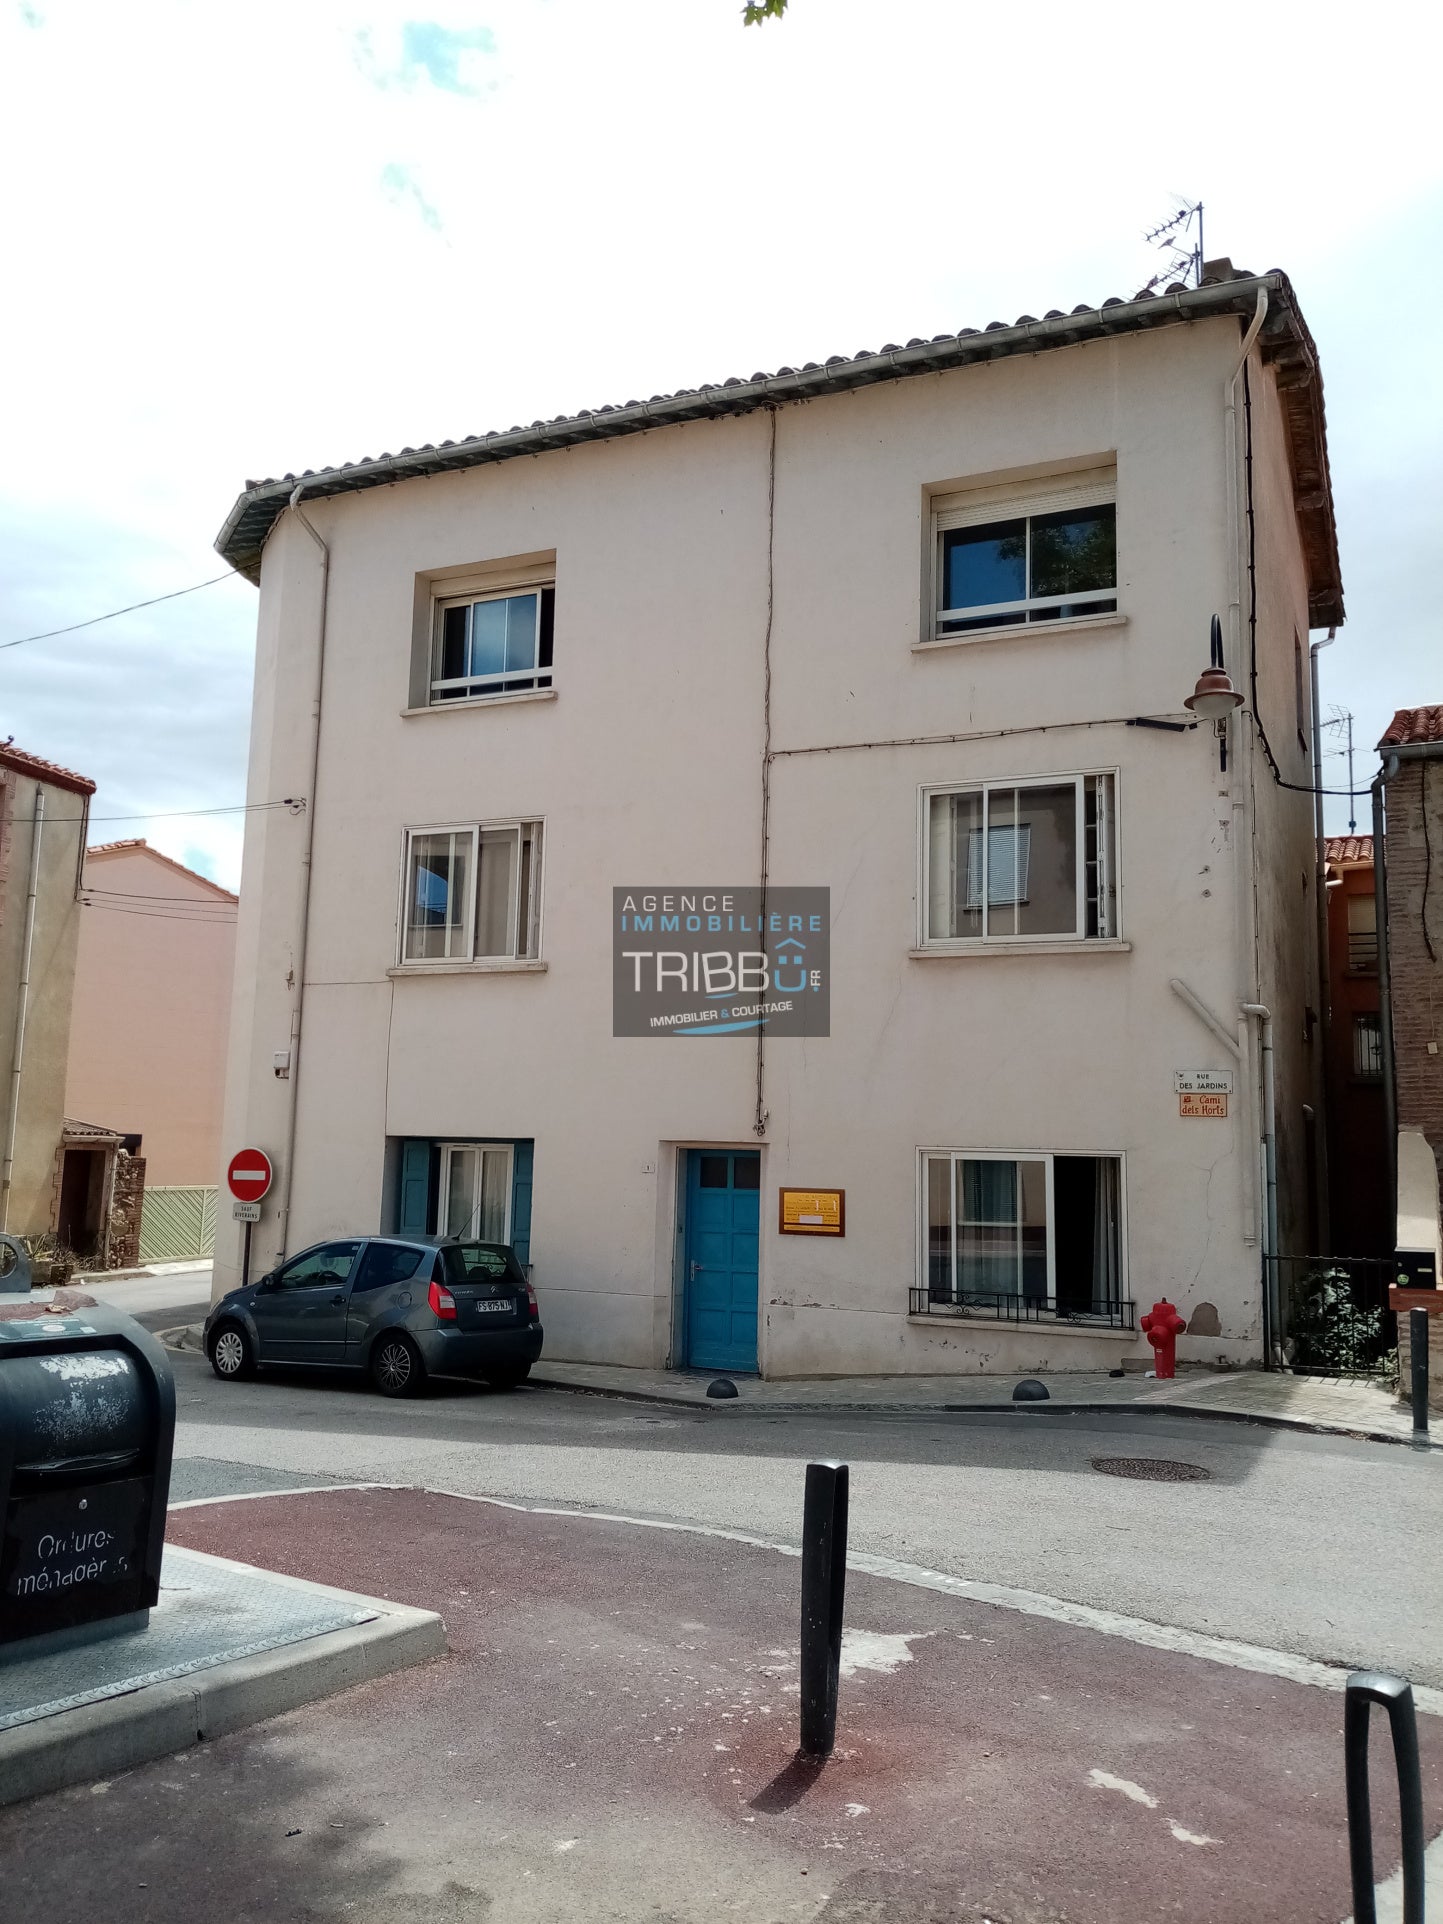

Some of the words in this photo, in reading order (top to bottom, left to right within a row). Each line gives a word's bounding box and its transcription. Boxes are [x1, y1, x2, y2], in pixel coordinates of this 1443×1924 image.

[1179, 1082, 1193, 1090] DES
[1197, 1082, 1228, 1090] JARDINS
[1199, 1094, 1221, 1105] Cami
[1182, 1105, 1199, 1115] dels
[1201, 1105, 1225, 1116] Horts
